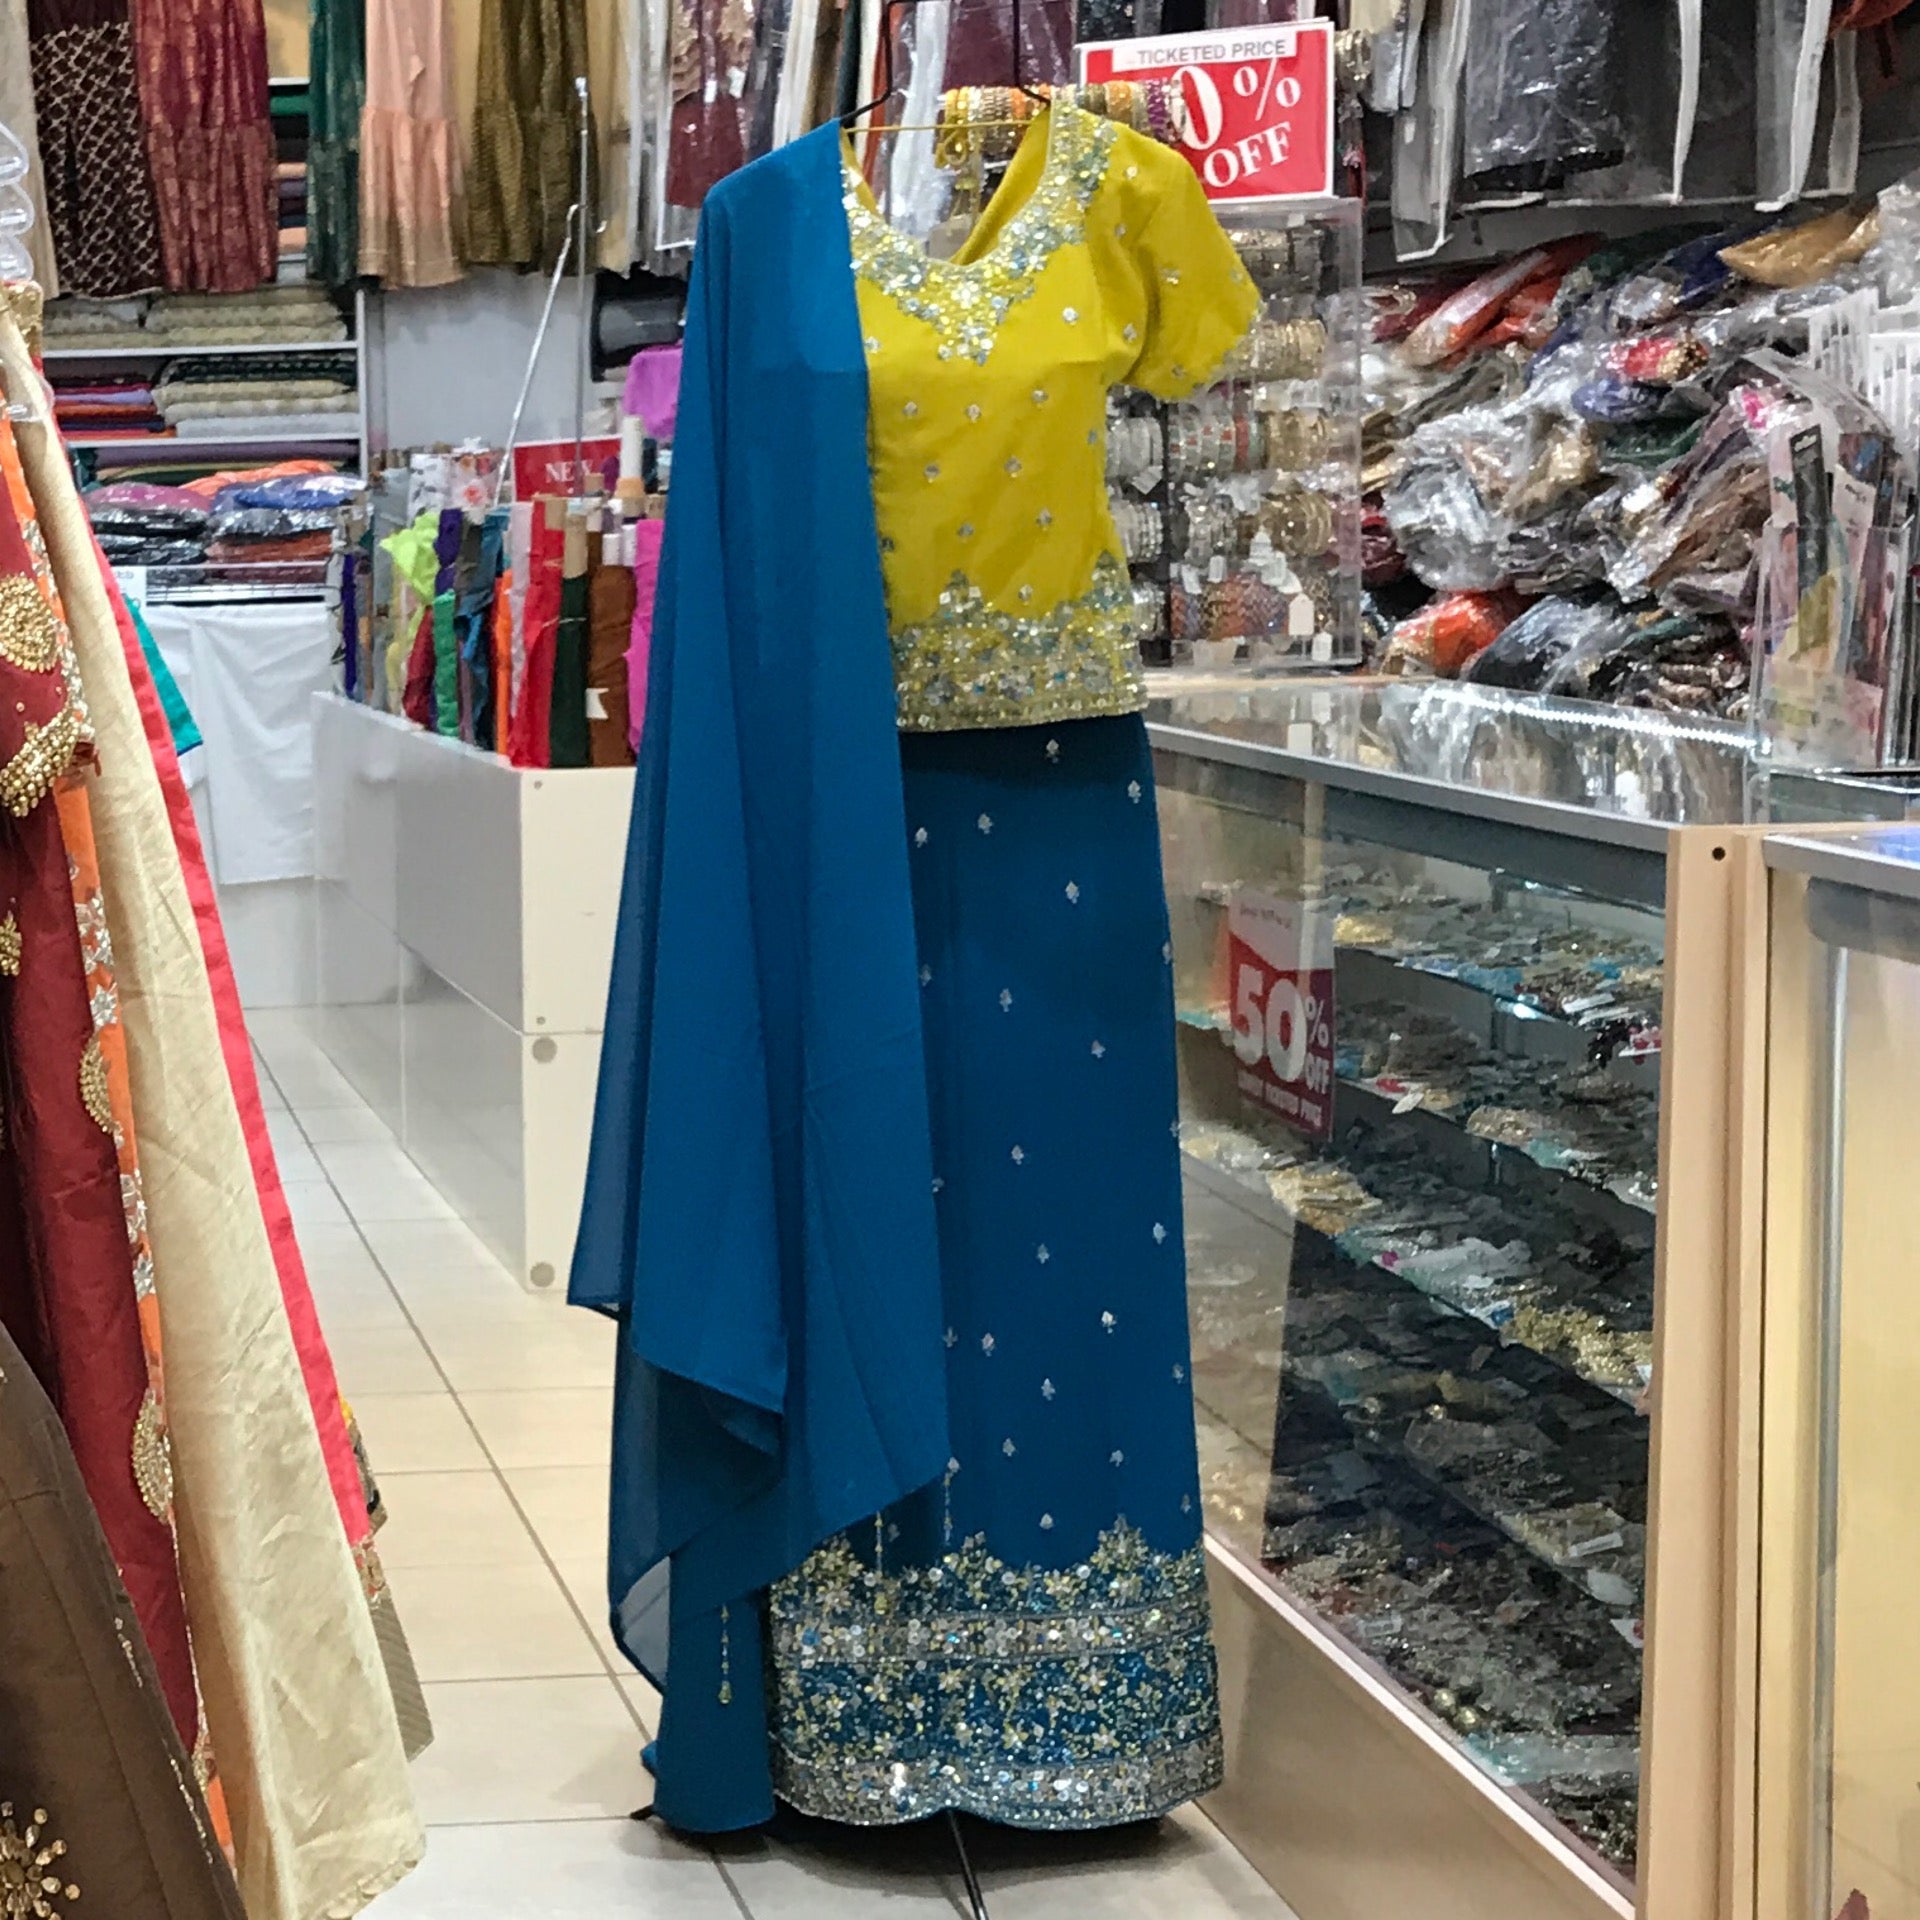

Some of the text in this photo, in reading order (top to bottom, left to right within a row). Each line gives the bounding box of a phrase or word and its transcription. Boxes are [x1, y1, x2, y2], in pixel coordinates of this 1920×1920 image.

[1138, 39, 1287, 65] TICKETED PRICE
[1203, 121, 1293, 188] OFF
